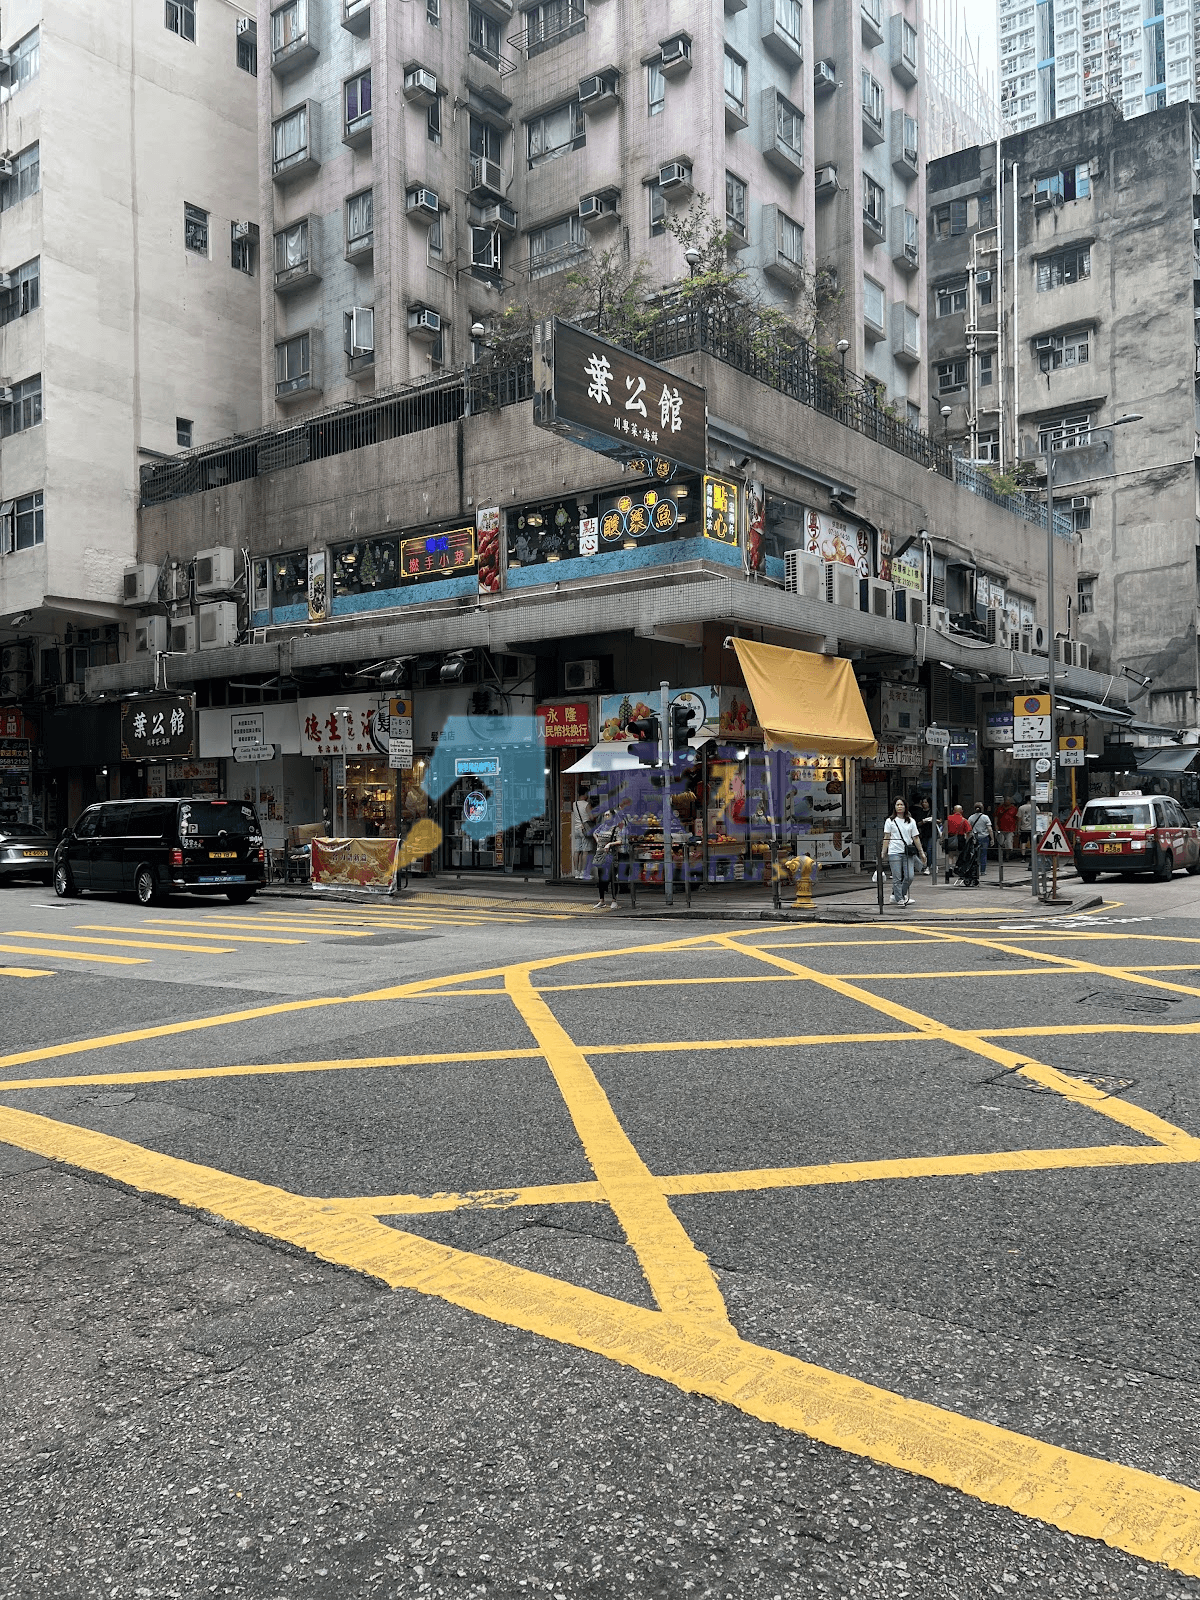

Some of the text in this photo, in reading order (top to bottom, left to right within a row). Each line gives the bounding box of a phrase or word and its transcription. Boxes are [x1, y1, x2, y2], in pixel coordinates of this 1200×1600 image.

[583, 352, 684, 434] 葉公館
[603, 503, 674, 537] 酸菜魚
[581, 519, 597, 551] 點心
[132, 707, 185, 739] 葉公館
[546, 707, 577, 724] 永隆
[1037, 717, 1044, 726] 7
[537, 723, 588, 738] 人民幣找換行
[1037, 730, 1044, 739] 7
